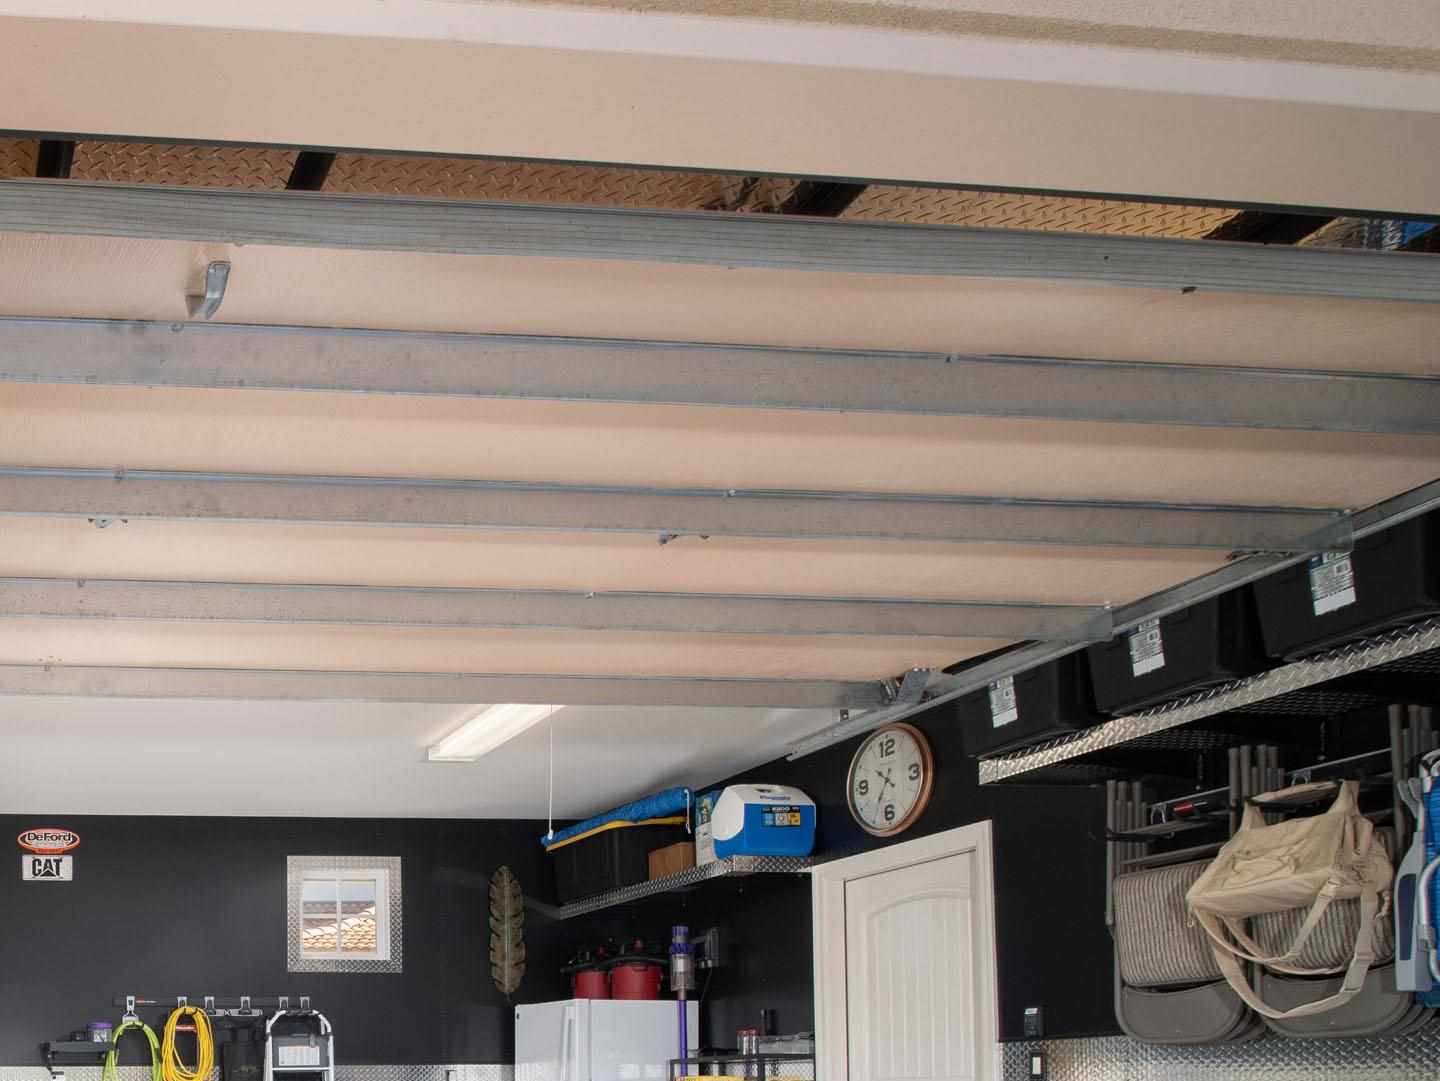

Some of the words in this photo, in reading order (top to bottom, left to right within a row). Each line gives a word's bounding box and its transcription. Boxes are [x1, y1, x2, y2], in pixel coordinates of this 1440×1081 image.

[879, 738, 895, 758] 12
[908, 763, 920, 781] 3
[859, 780, 869, 796] 9
[884, 804, 895, 821] 6
[27, 832, 71, 841] DeFord
[32, 858, 62, 877] CAT
